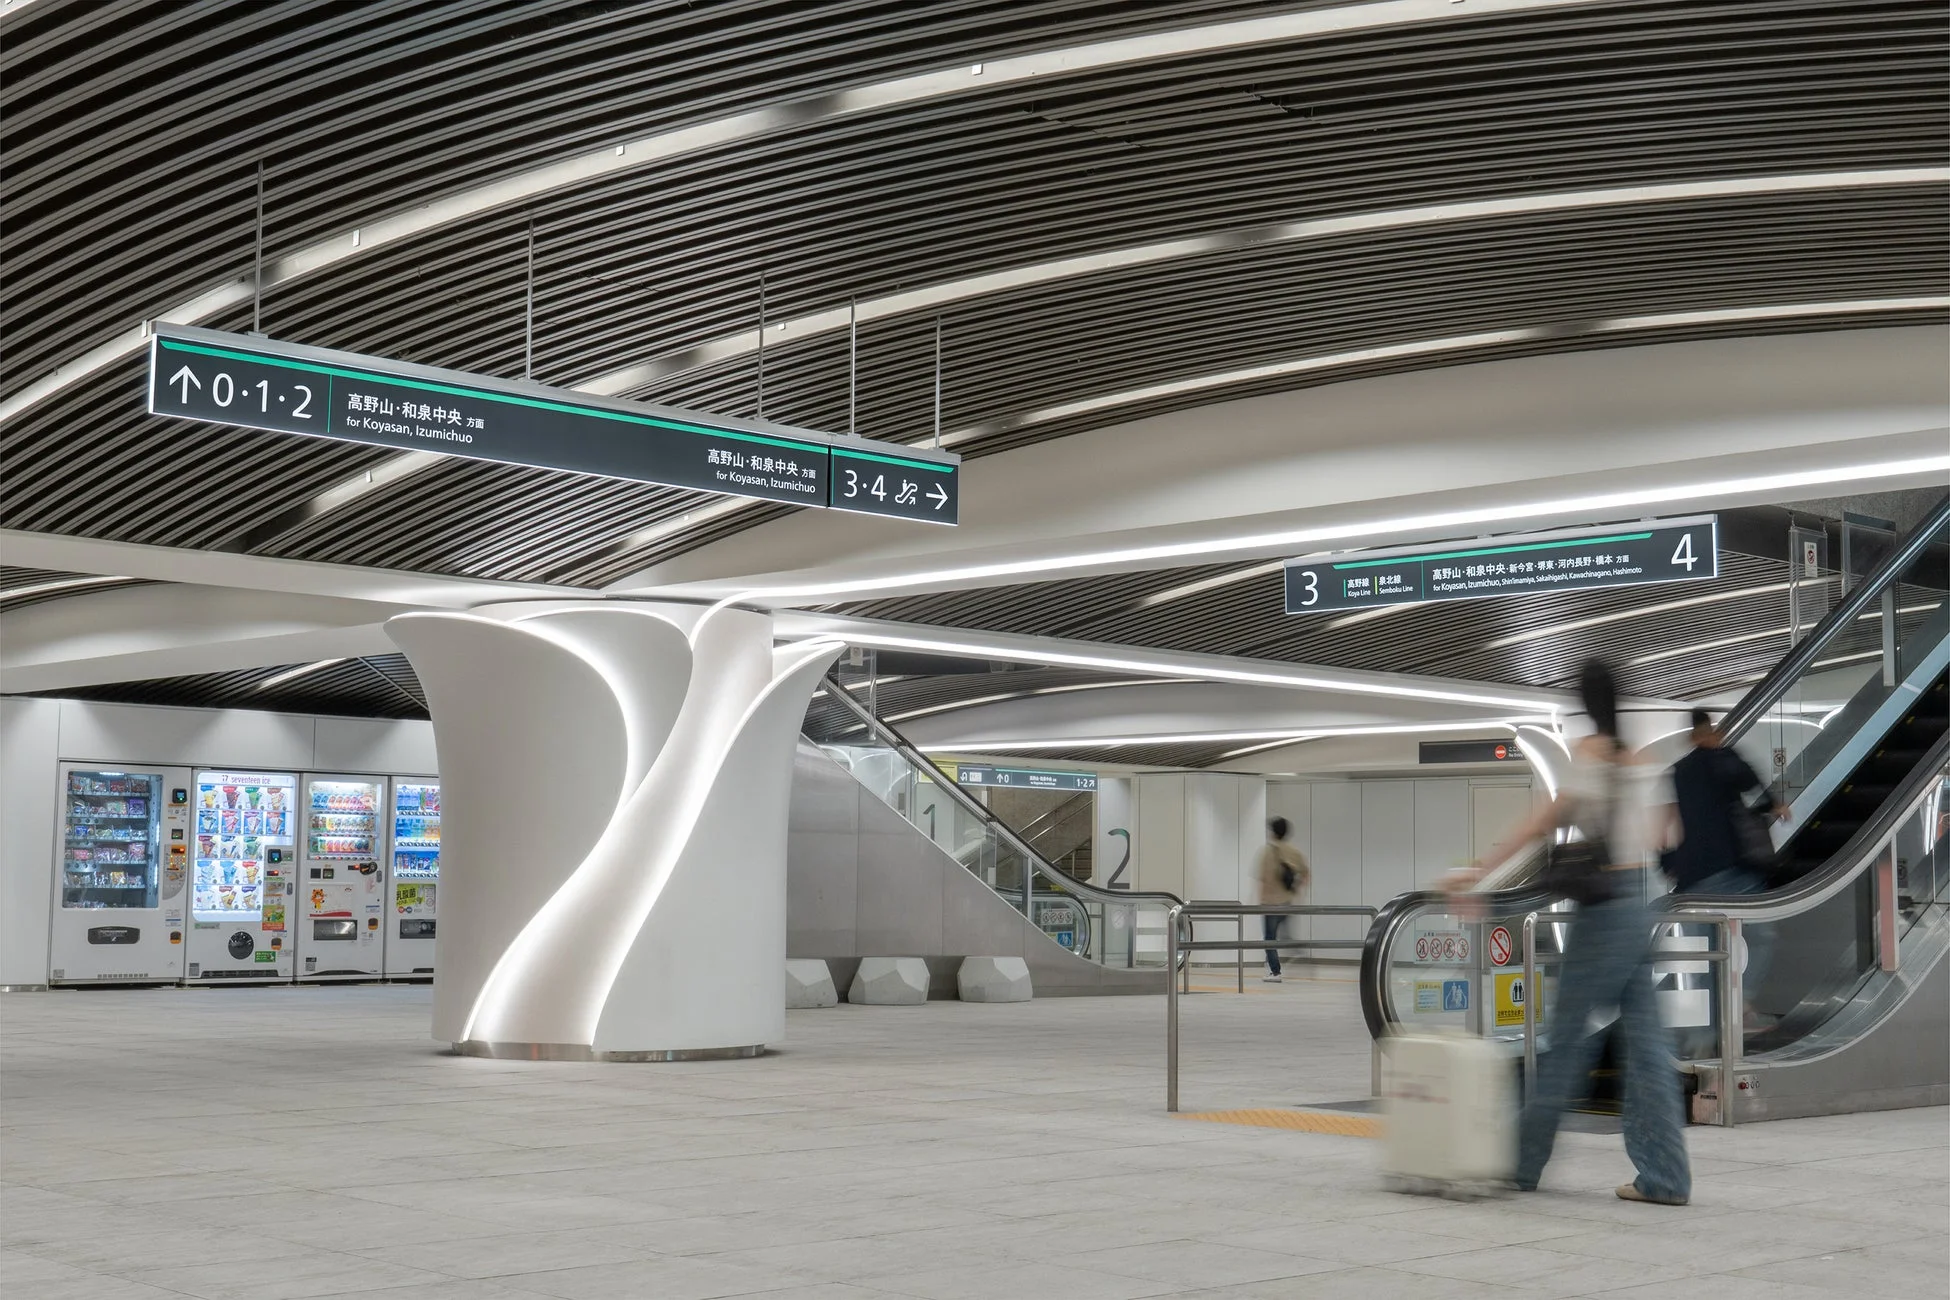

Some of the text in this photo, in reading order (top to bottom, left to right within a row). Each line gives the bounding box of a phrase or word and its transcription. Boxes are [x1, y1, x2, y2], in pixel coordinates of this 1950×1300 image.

[348, 393, 485, 429] 高野山・和泉中央 方面
[346, 416, 473, 443] for Koyasan, Izumichuo
[708, 448, 816, 479] 高野山・和泉中央 方面
[716, 470, 816, 493] for Koyasan, Izumichuo
[1671, 534, 1698, 571] 4
[1301, 571, 1318, 606] 3
[1347, 589, 1371, 598] Koya Line
[1379, 585, 1414, 595] Semboku Line
[1441, 582, 1467, 592] Koyasan,
[1468, 578, 1501, 588] Izumichuo,
[1613, 567, 1643, 576] Hashimoto
[1004, 774, 1010, 784] 0
[923, 804, 935, 841] 1
[1107, 828, 1130, 889] 2
